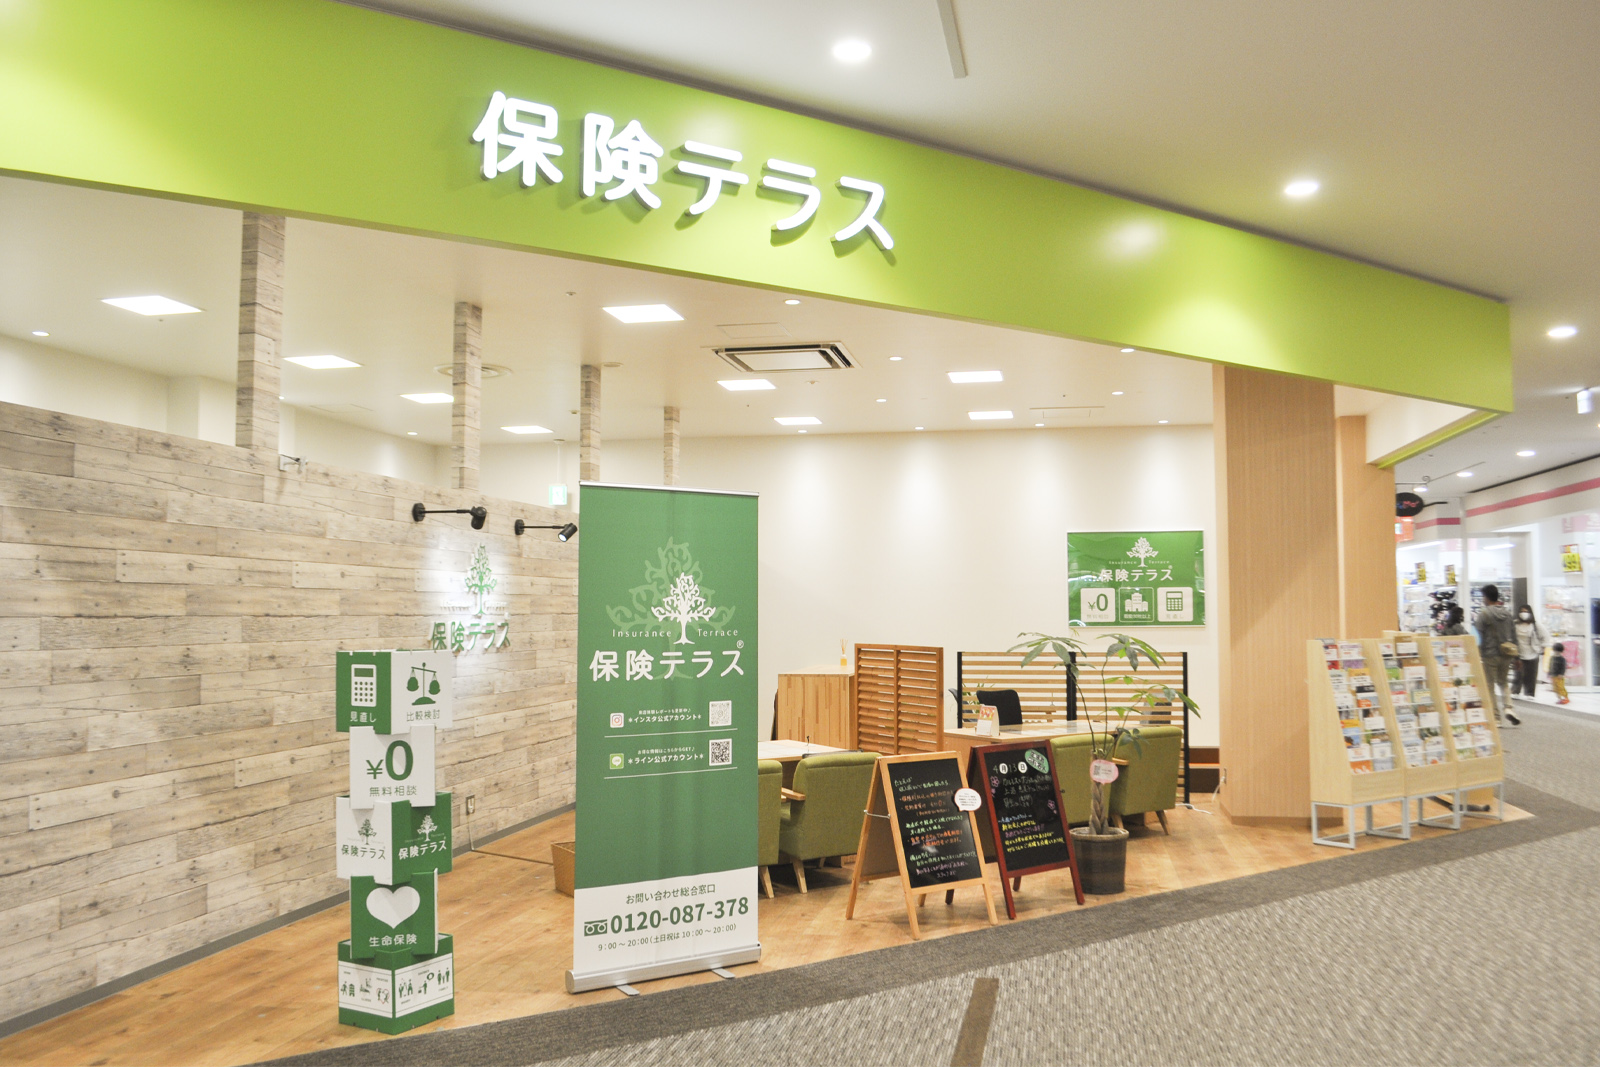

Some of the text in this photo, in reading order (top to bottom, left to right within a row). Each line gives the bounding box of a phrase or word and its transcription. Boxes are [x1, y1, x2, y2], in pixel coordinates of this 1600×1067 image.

[470, 90, 894, 251] 保険テラス
[1100, 569, 1173, 582] 保険テラス
[429, 621, 511, 652] 保険テラス
[612, 628, 739, 638] Insurance Terrace
[589, 649, 744, 682] 保険テラス
[350, 711, 377, 723] 見直し
[406, 709, 441, 722] 比較検討
[366, 740, 414, 781] ¥0
[369, 785, 417, 797] 無料相談
[341, 844, 386, 861] 保険テラス
[398, 840, 447, 860] 保険テラス
[626, 884, 716, 905] お問い合わせ総合窓口
[610, 897, 749, 934] 0120-087-378
[368, 933, 418, 947] 生命保険
